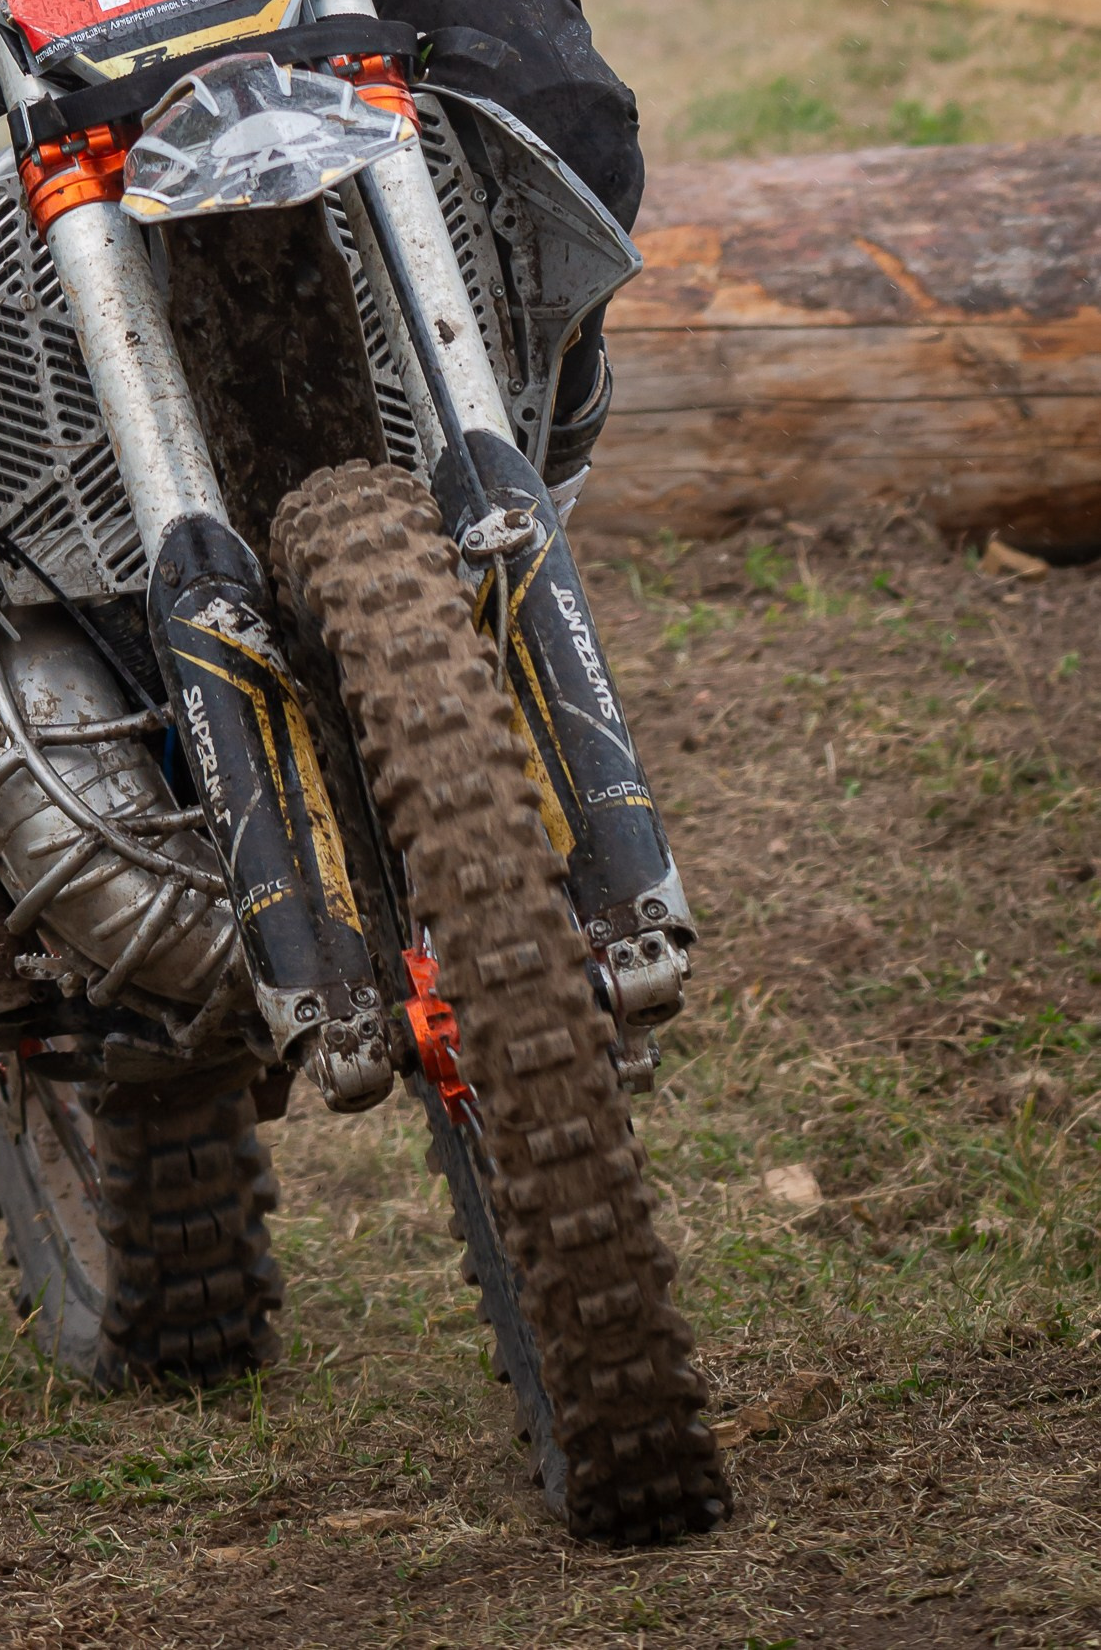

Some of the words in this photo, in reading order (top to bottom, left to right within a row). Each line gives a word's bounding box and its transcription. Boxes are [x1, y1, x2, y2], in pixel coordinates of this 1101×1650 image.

[551, 581, 621, 724] SUPERMOT
[182, 685, 231, 827] SUPERMT
[587, 781, 649, 803] GoPro
